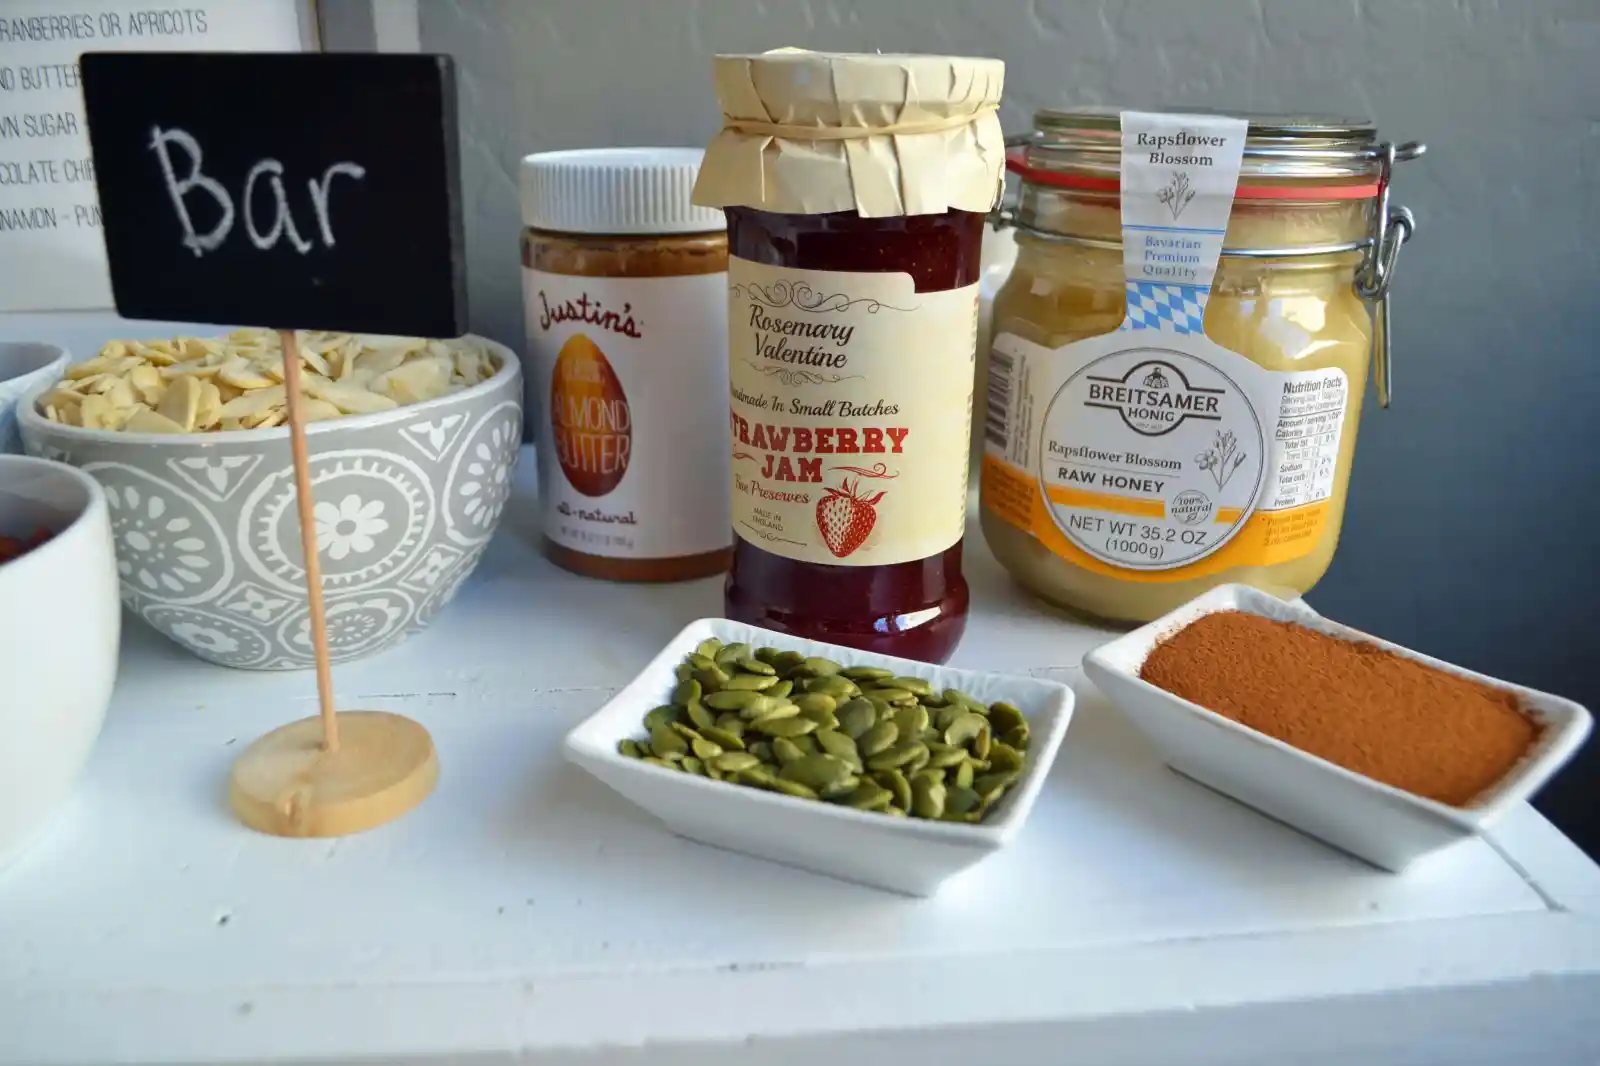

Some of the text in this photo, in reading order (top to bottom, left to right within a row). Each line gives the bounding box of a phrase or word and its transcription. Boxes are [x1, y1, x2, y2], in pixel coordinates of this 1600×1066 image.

[0, 9, 208, 41] RANBERRIES OR APRICOTS
[24, 112, 79, 138] SUGAR
[1137, 131, 1228, 151] Rapsflower
[1149, 152, 1213, 167] Blossom
[149, 125, 366, 258] Bar
[1145, 235, 1201, 250] Bavarian
[1144, 250, 1200, 264] Premium
[1142, 264, 1198, 280] Quality
[539, 290, 641, 338] Justin's
[750, 303, 854, 347] Rosemary
[755, 332, 848, 369] Valentine
[1284, 376, 1342, 394] Nutrition Facts
[771, 395, 785, 412] In
[789, 398, 836, 417] Small
[838, 399, 899, 417] Batches
[1089, 383, 1219, 413] BREITSAMER
[1128, 407, 1175, 422] HONIG
[732, 412, 909, 454] TRAWBERRY
[1048, 440, 1182, 470] Rapsflower Blossom
[761, 454, 823, 483] JAM
[1058, 467, 1165, 493] RAW HONEY
[751, 480, 810, 504] Preserves
[1171, 502, 1213, 514] natural
[752, 515, 784, 532] ENGLAND
[1070, 514, 1208, 545] NET WT 35.2 OZ
[1105, 538, 1164, 559] (1000g)
